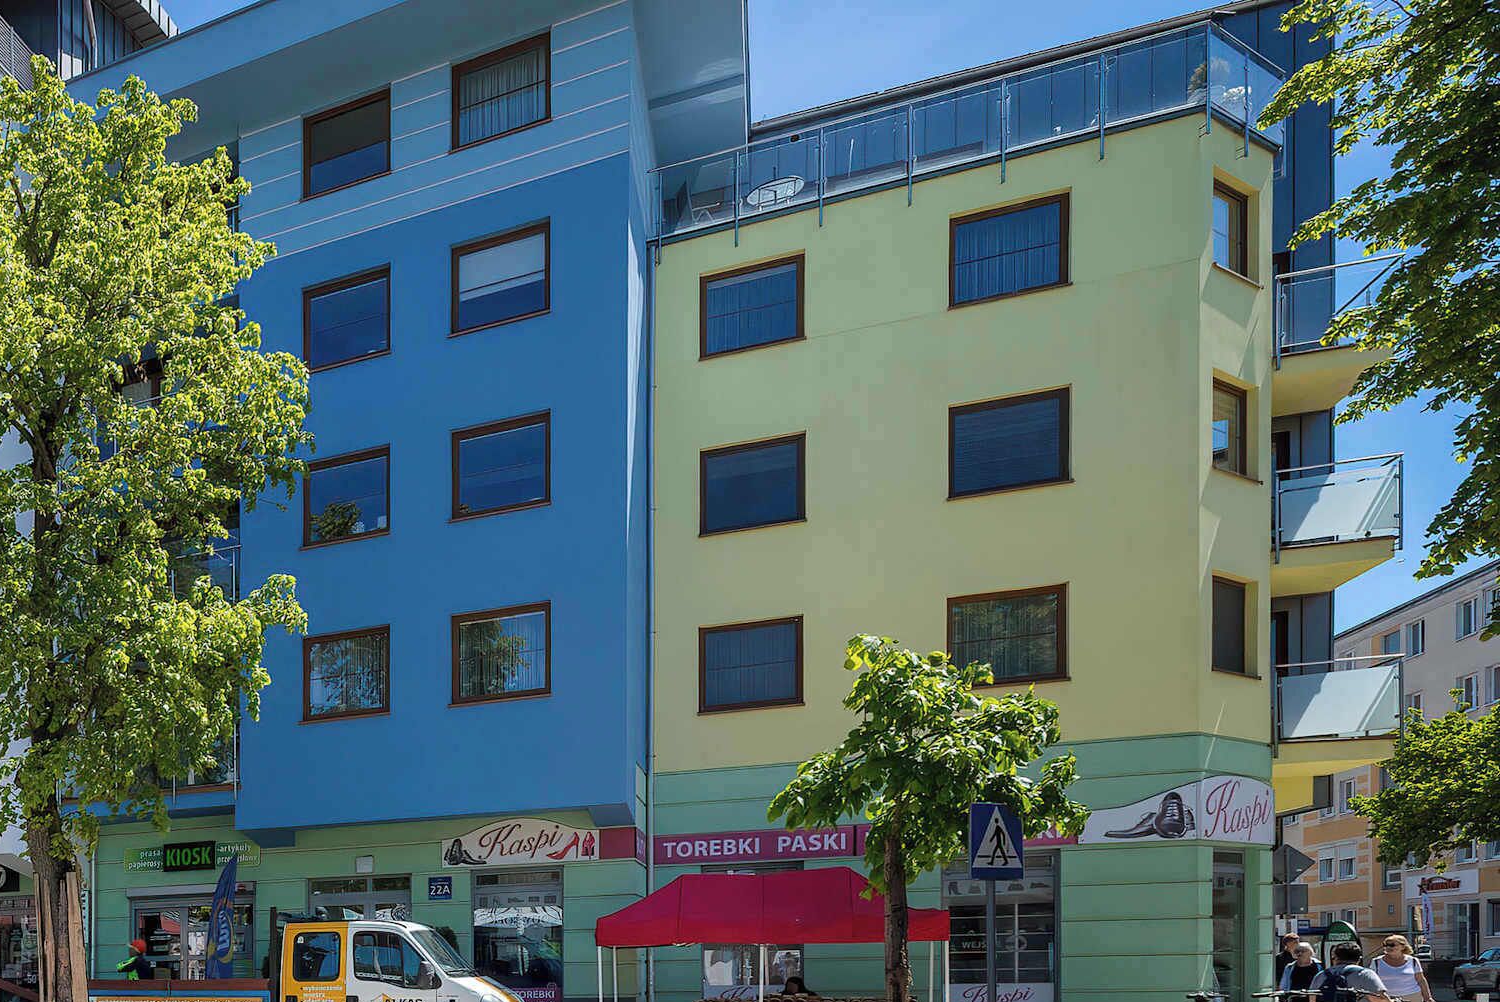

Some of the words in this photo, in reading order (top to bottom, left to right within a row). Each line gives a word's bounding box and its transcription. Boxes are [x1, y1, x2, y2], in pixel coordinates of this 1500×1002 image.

[1204, 777, 1271, 840] Kaspi
[478, 823, 563, 860] Kaspi
[662, 837, 760, 859] TOREBKI
[777, 832, 847, 853] PASKI
[165, 846, 211, 867] KIOSK
[430, 885, 451, 896] 22A
